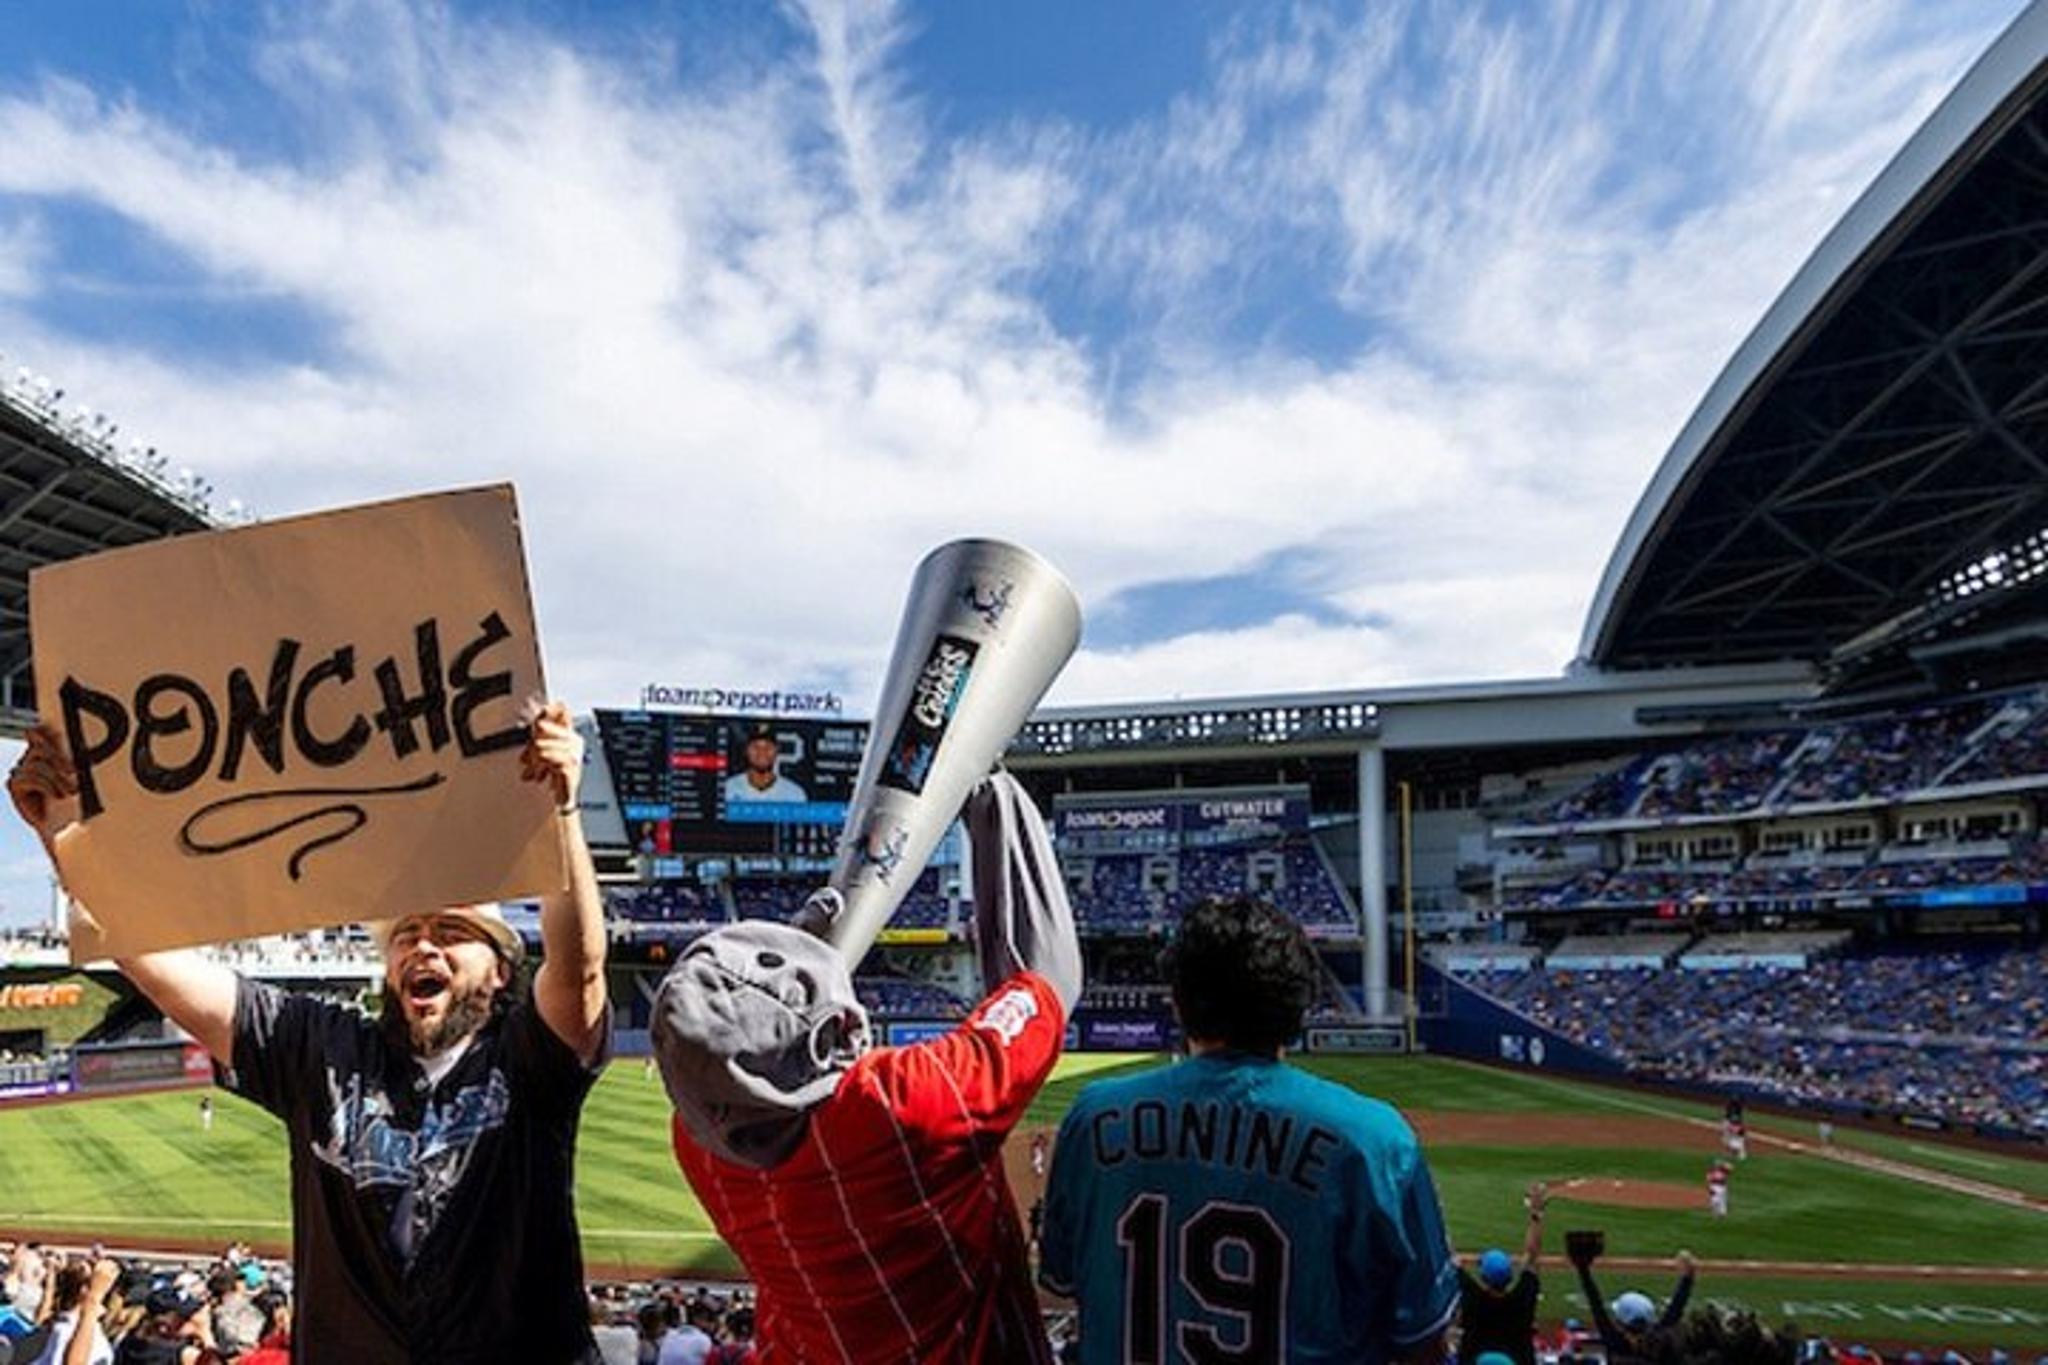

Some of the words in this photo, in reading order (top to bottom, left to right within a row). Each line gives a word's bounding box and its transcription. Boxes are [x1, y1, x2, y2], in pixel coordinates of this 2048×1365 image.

[58, 610, 532, 820] PONCHE
[784, 690, 837, 713] park
[1201, 799, 1286, 818] CUTWATER
[1090, 1095, 1342, 1197] CONINE
[1117, 1193, 1290, 1365] 19
